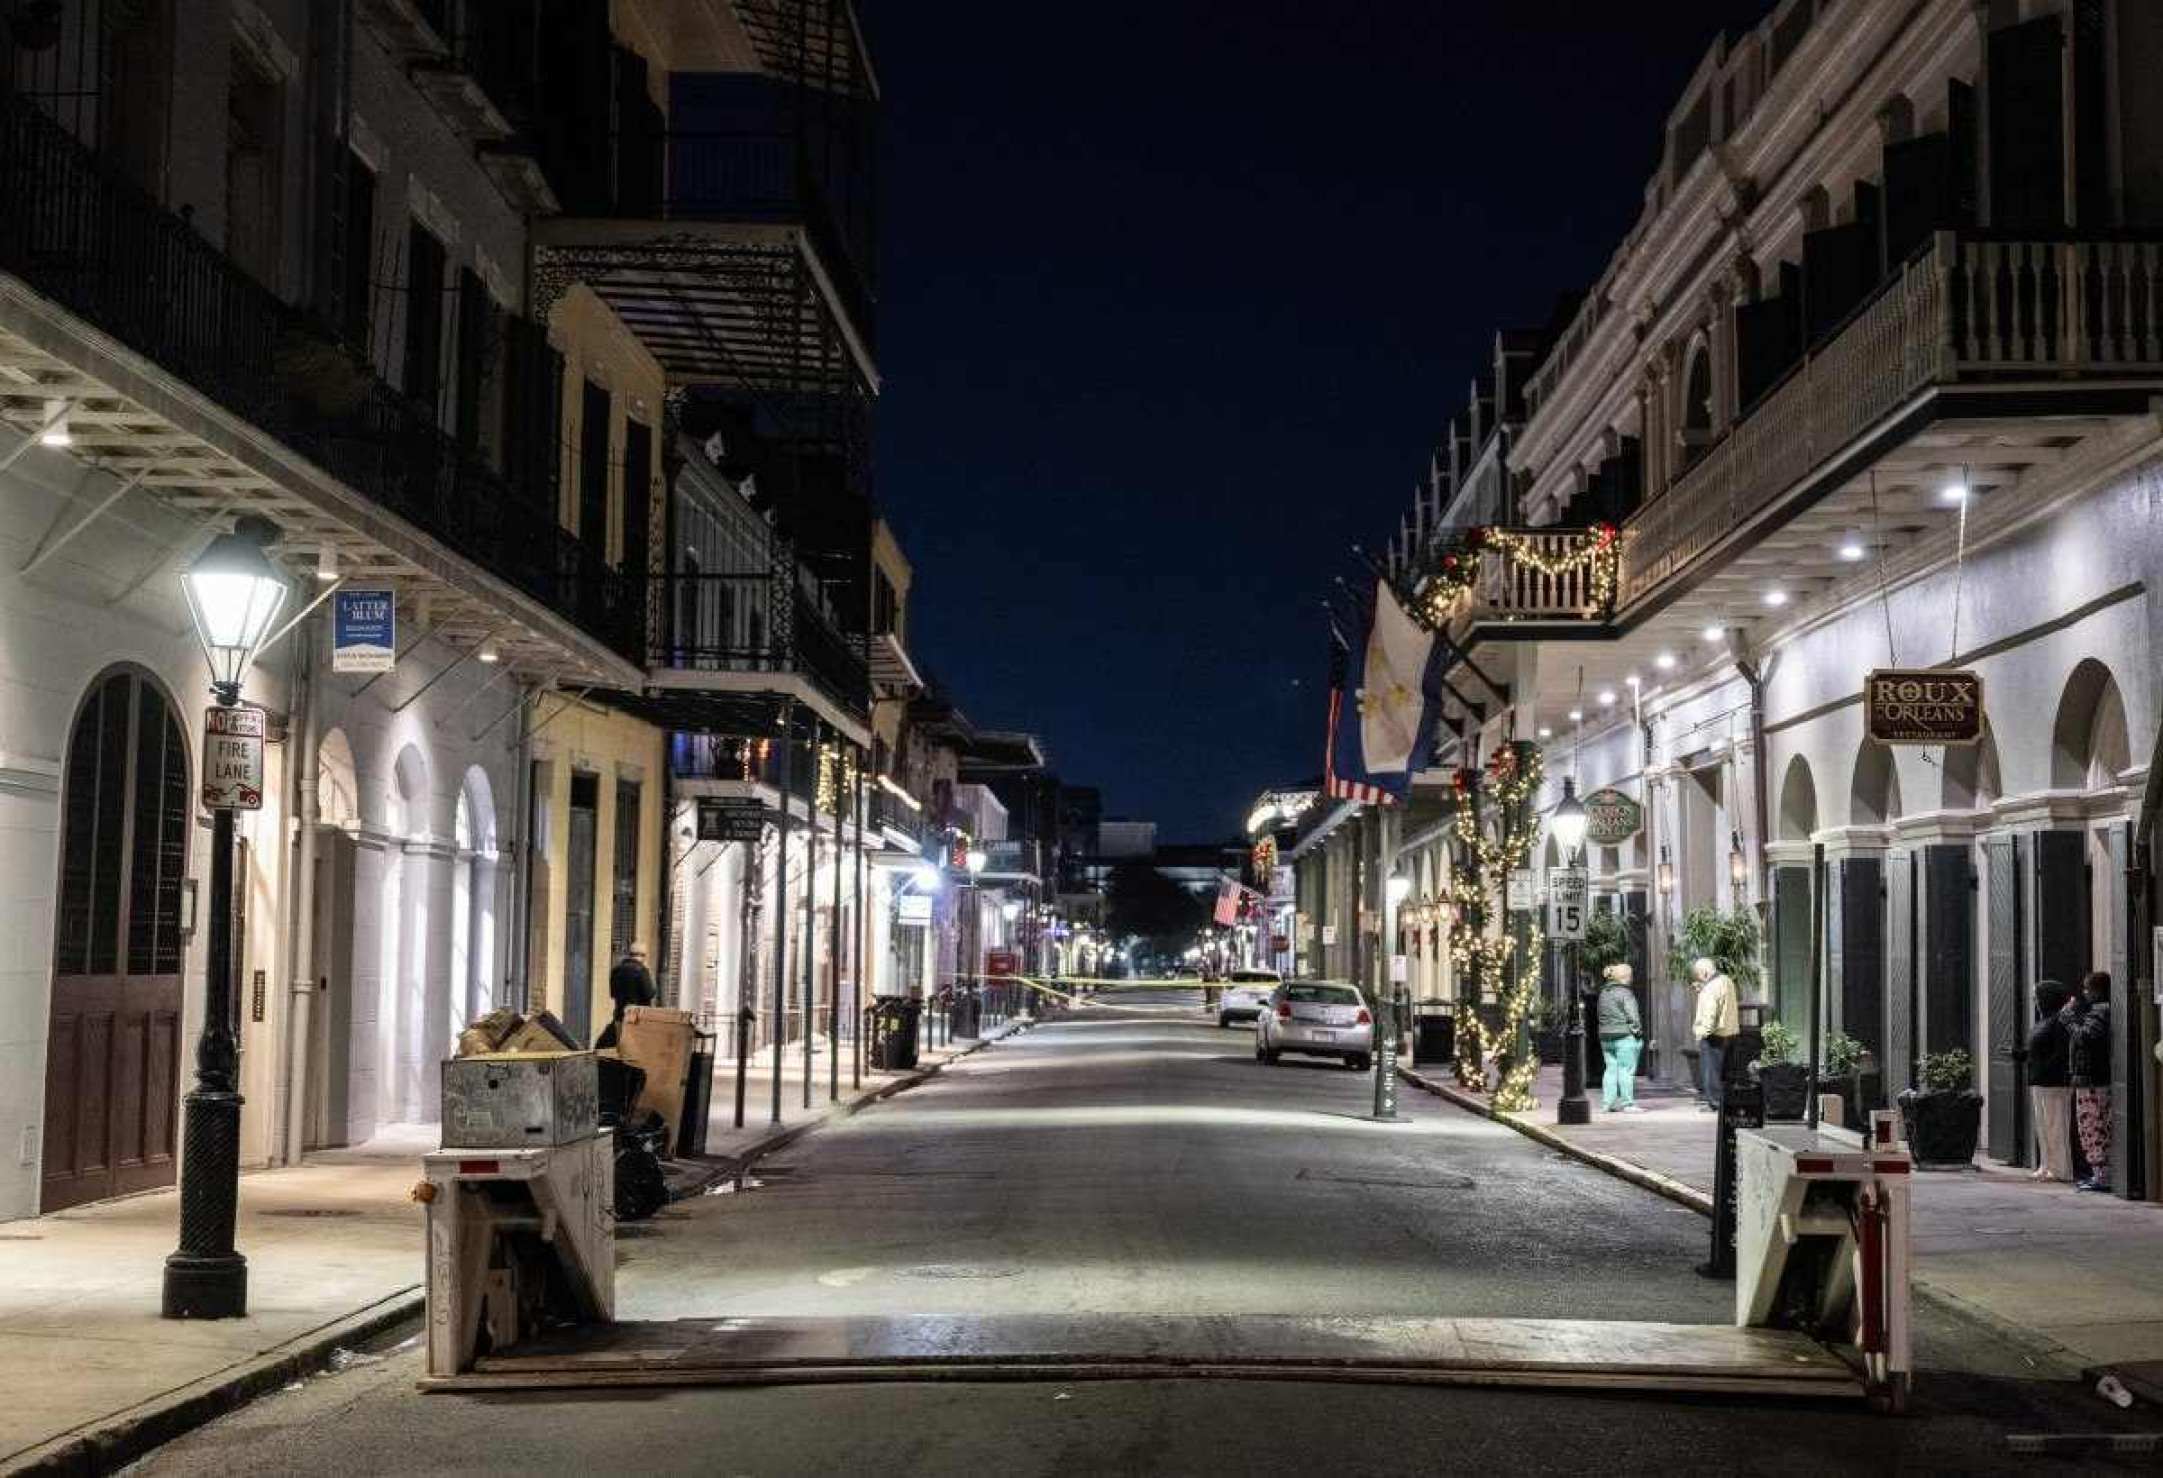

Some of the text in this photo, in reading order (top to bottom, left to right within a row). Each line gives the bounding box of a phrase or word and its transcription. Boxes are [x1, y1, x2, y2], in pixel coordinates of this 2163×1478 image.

[1874, 681, 1974, 702] ROUX
[1885, 703, 1965, 722] ORLEANS
[218, 741, 249, 759] FIRE
[215, 762, 250, 780] LANE
[1552, 877, 1585, 888] SPEED
[1555, 891, 1583, 903] LIMIT
[1556, 906, 1580, 932] 15
